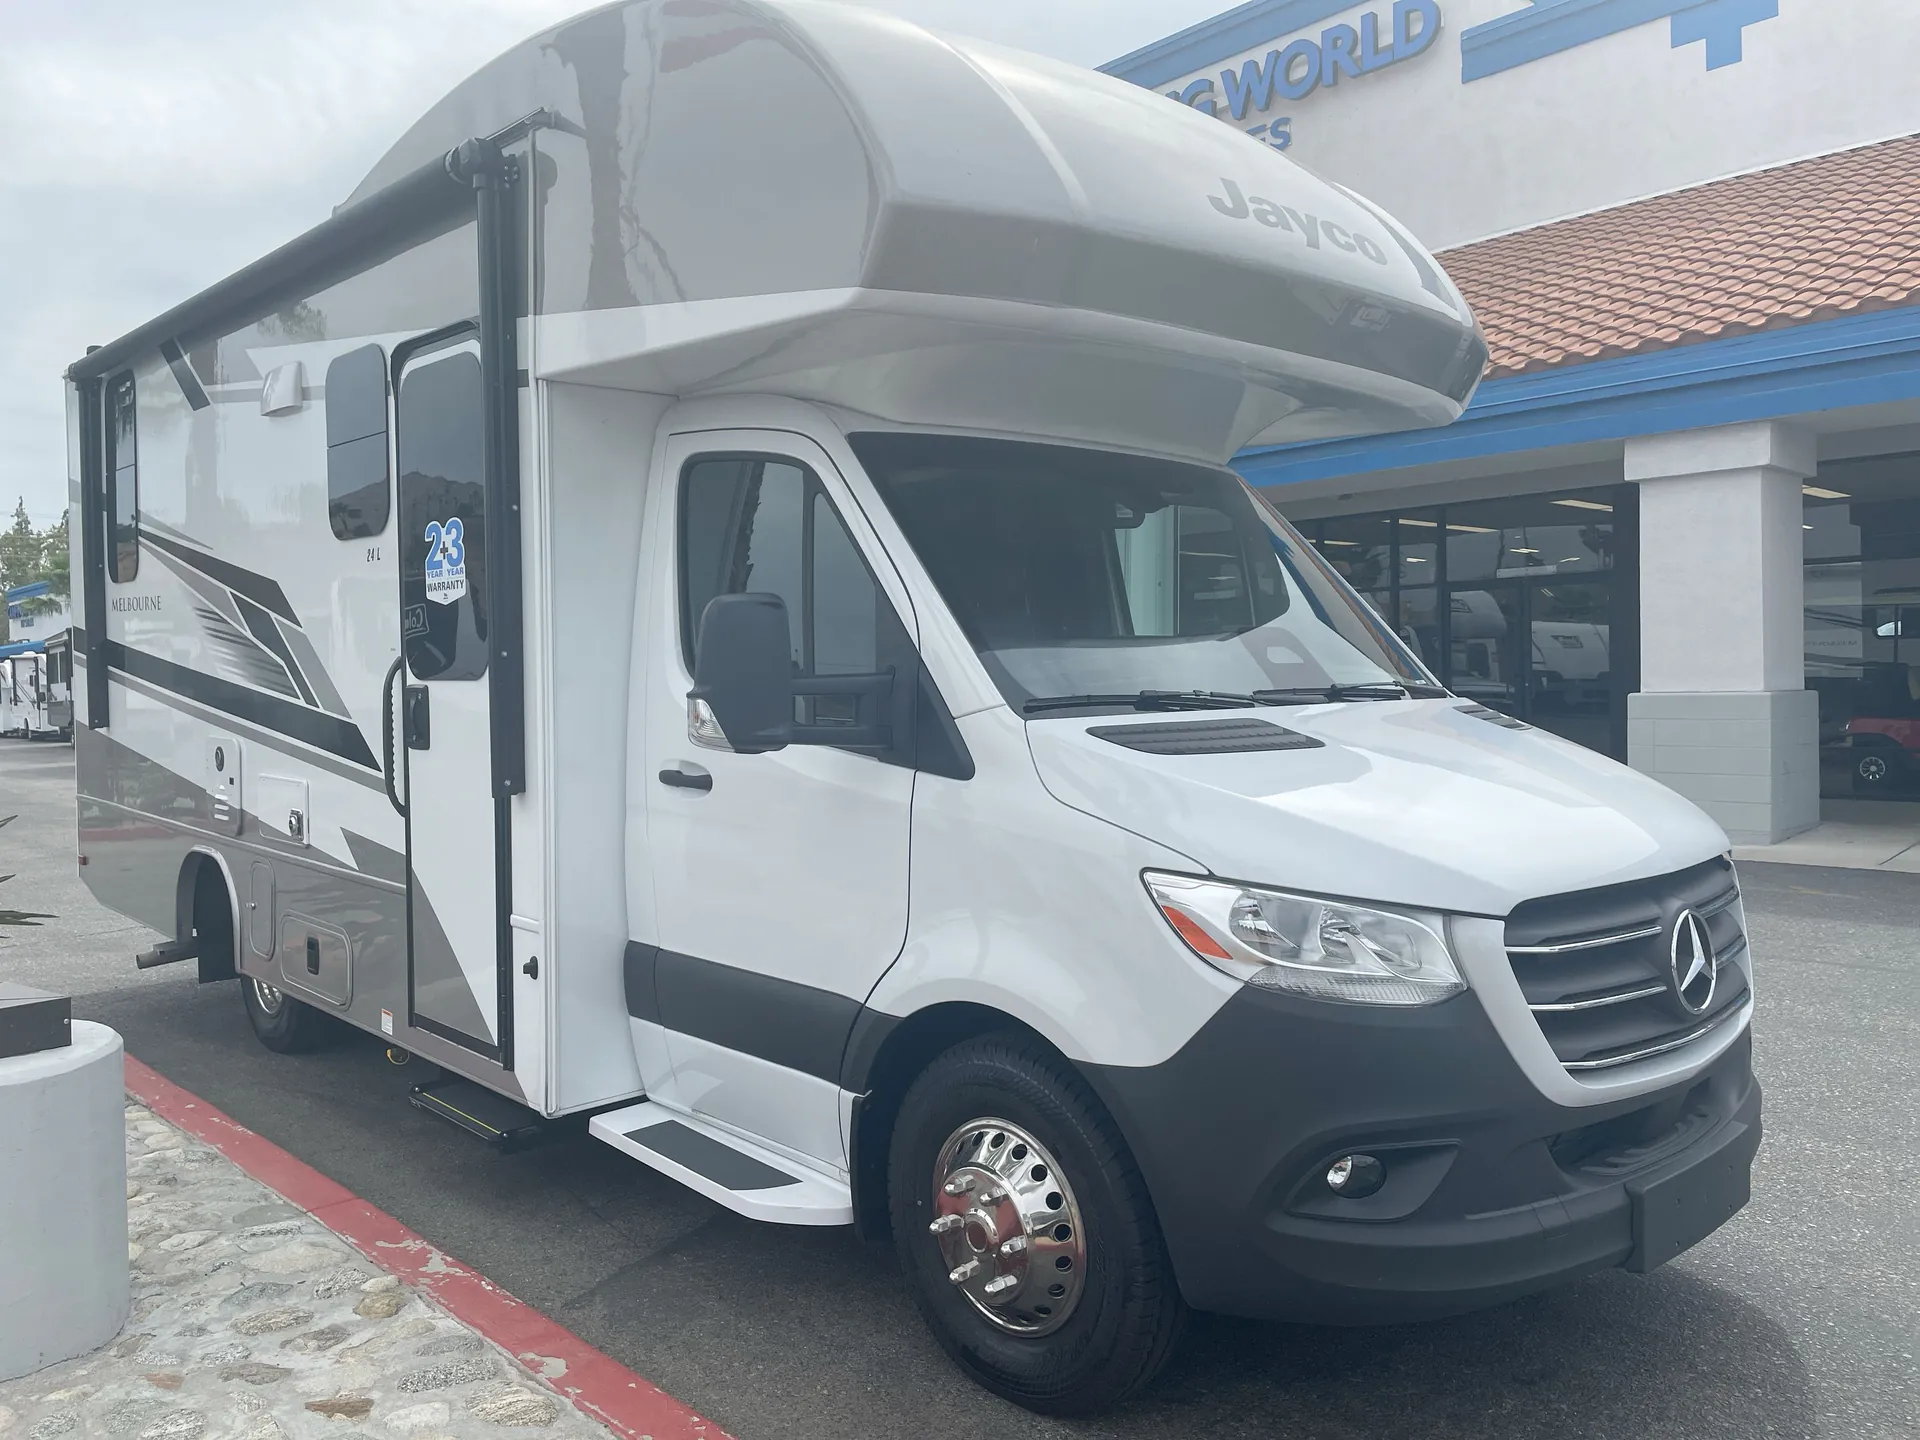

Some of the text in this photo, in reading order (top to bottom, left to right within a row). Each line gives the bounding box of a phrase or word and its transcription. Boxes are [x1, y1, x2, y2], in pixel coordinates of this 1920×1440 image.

[1220, 0, 1441, 121] WORLD
[1206, 177, 1388, 265] Jayco
[427, 567, 464, 579] YEAR YEAR
[427, 579, 465, 593] WARRANTY
[111, 596, 162, 612] MELBOURNE
